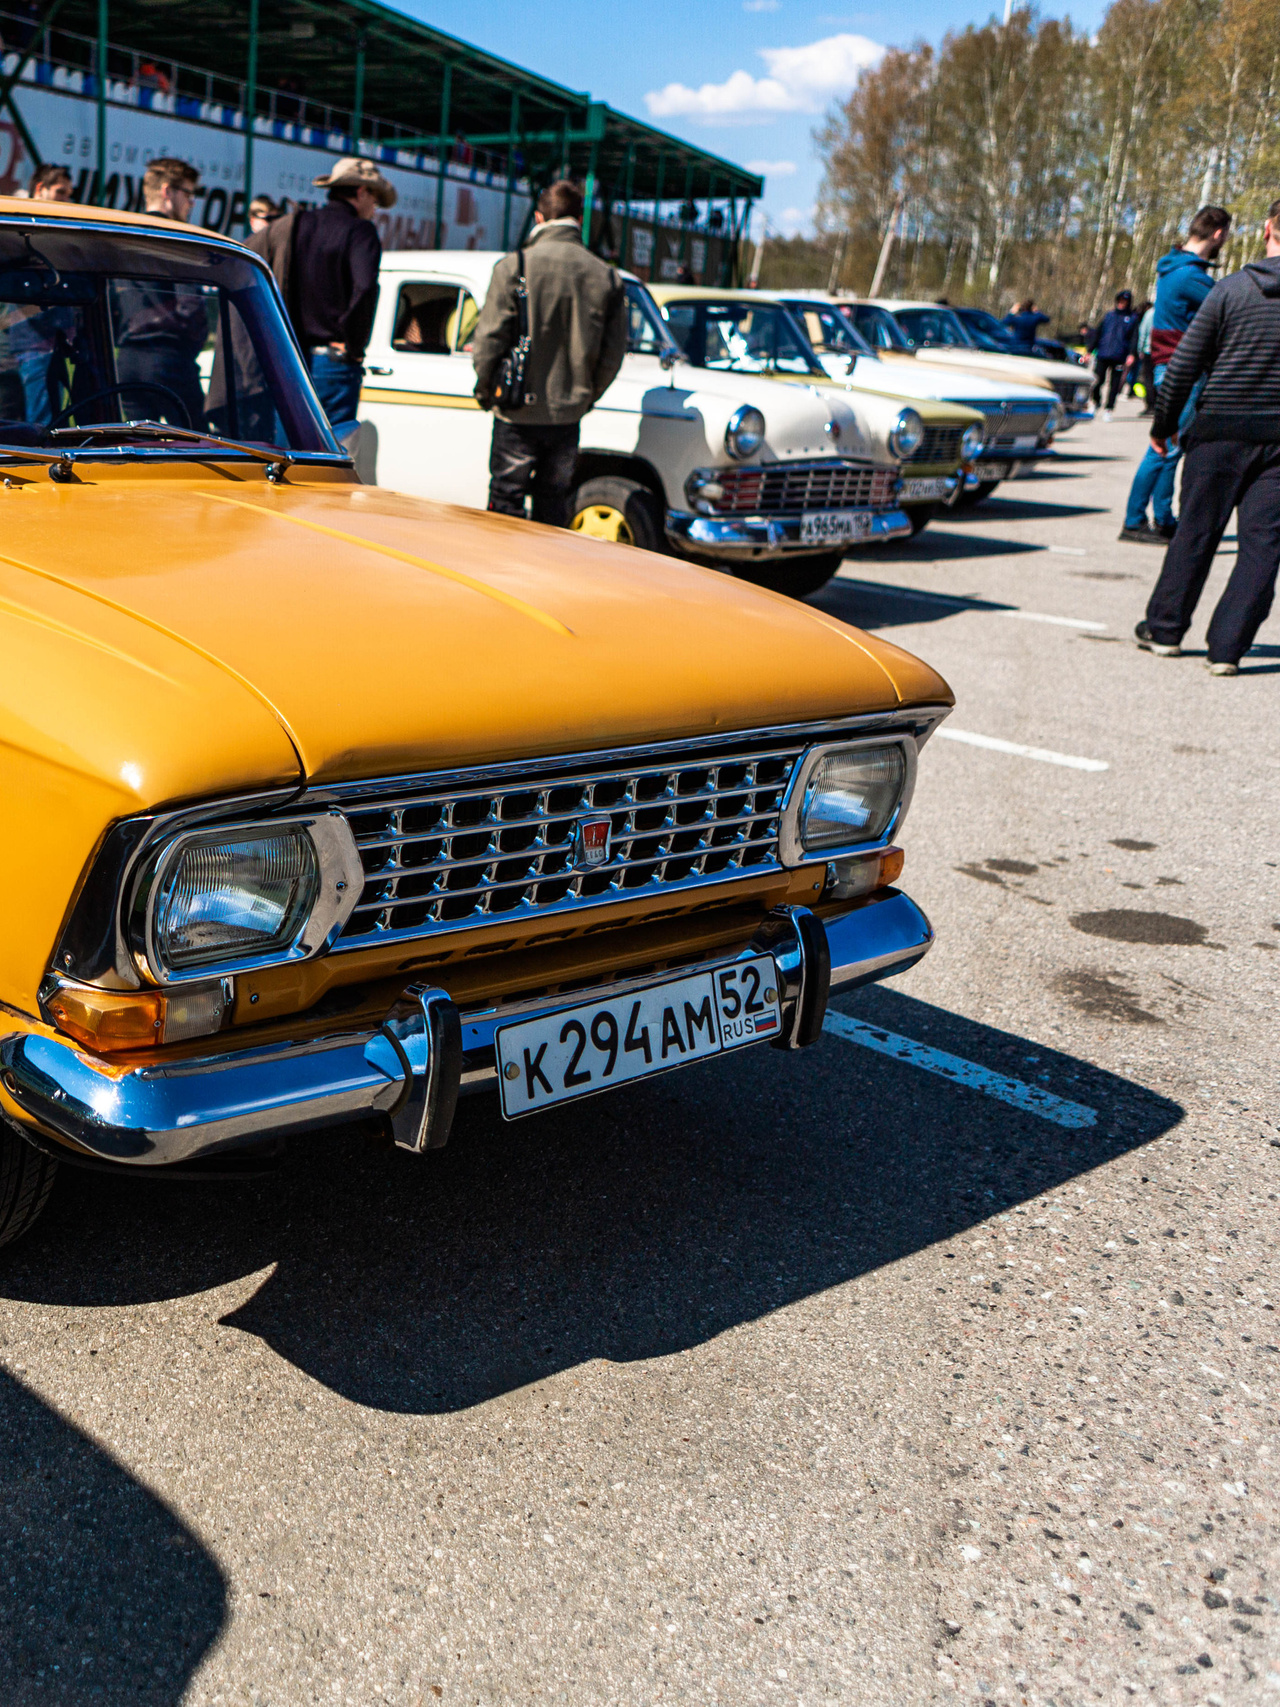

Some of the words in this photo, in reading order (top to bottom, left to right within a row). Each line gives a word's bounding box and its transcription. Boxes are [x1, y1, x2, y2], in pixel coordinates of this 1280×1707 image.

[523, 995, 716, 1100] К294АМ
[719, 965, 765, 1019] 52
[723, 1017, 755, 1042] RUS
